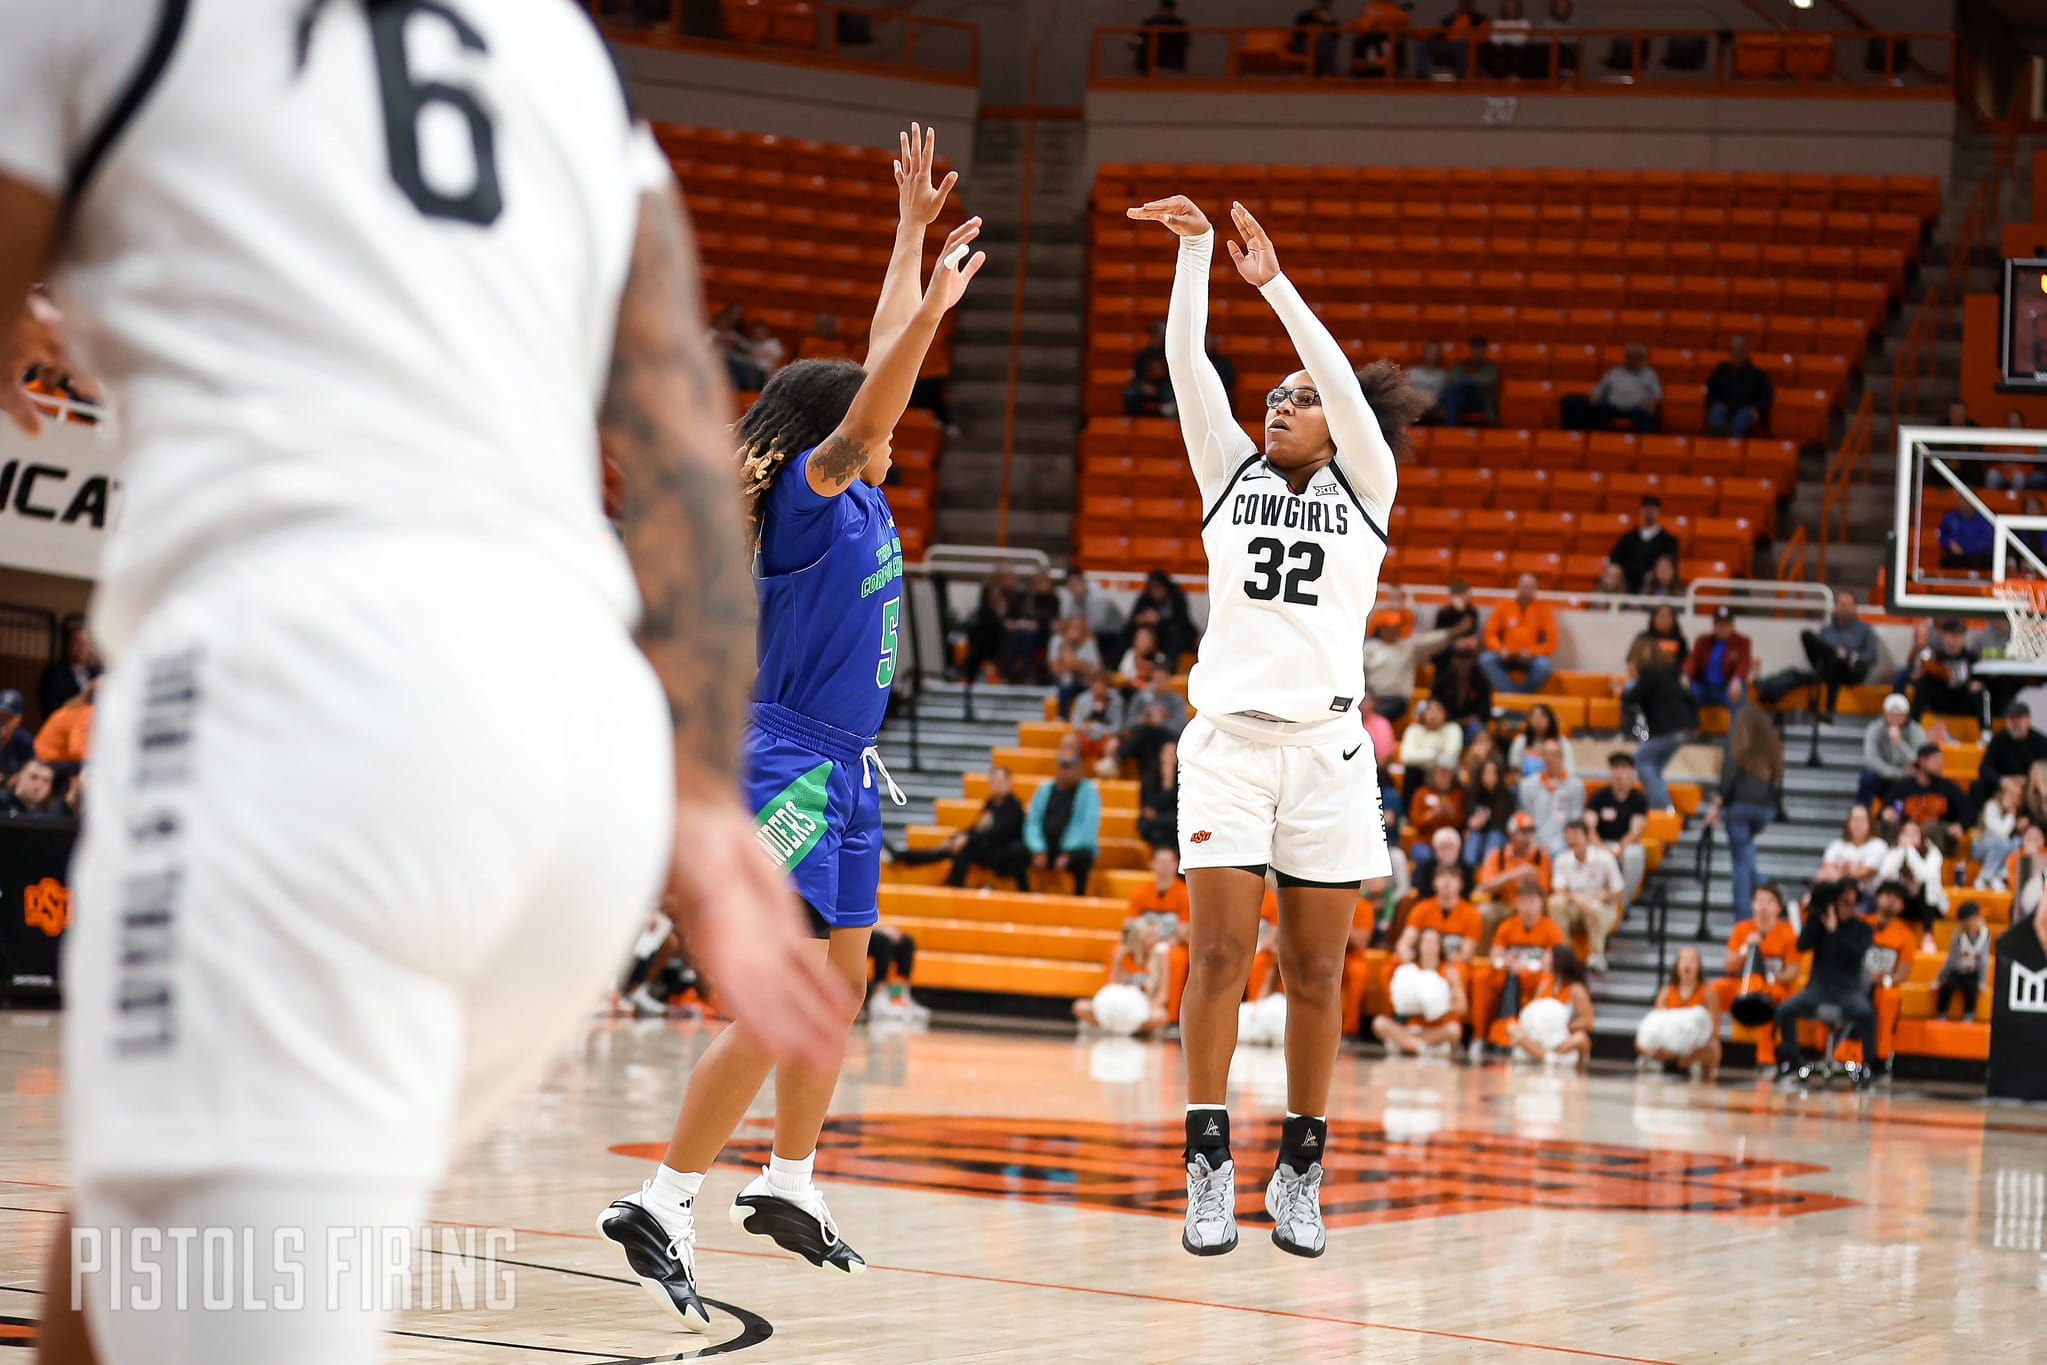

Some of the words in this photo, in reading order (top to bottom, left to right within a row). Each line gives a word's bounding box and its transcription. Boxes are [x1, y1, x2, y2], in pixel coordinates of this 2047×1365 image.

[366, 0, 503, 227] 6
[0, 459, 120, 530] ICA
[1232, 493, 1348, 535] COWGIRLS
[1243, 537, 1325, 606] 32
[875, 596, 900, 689] 5
